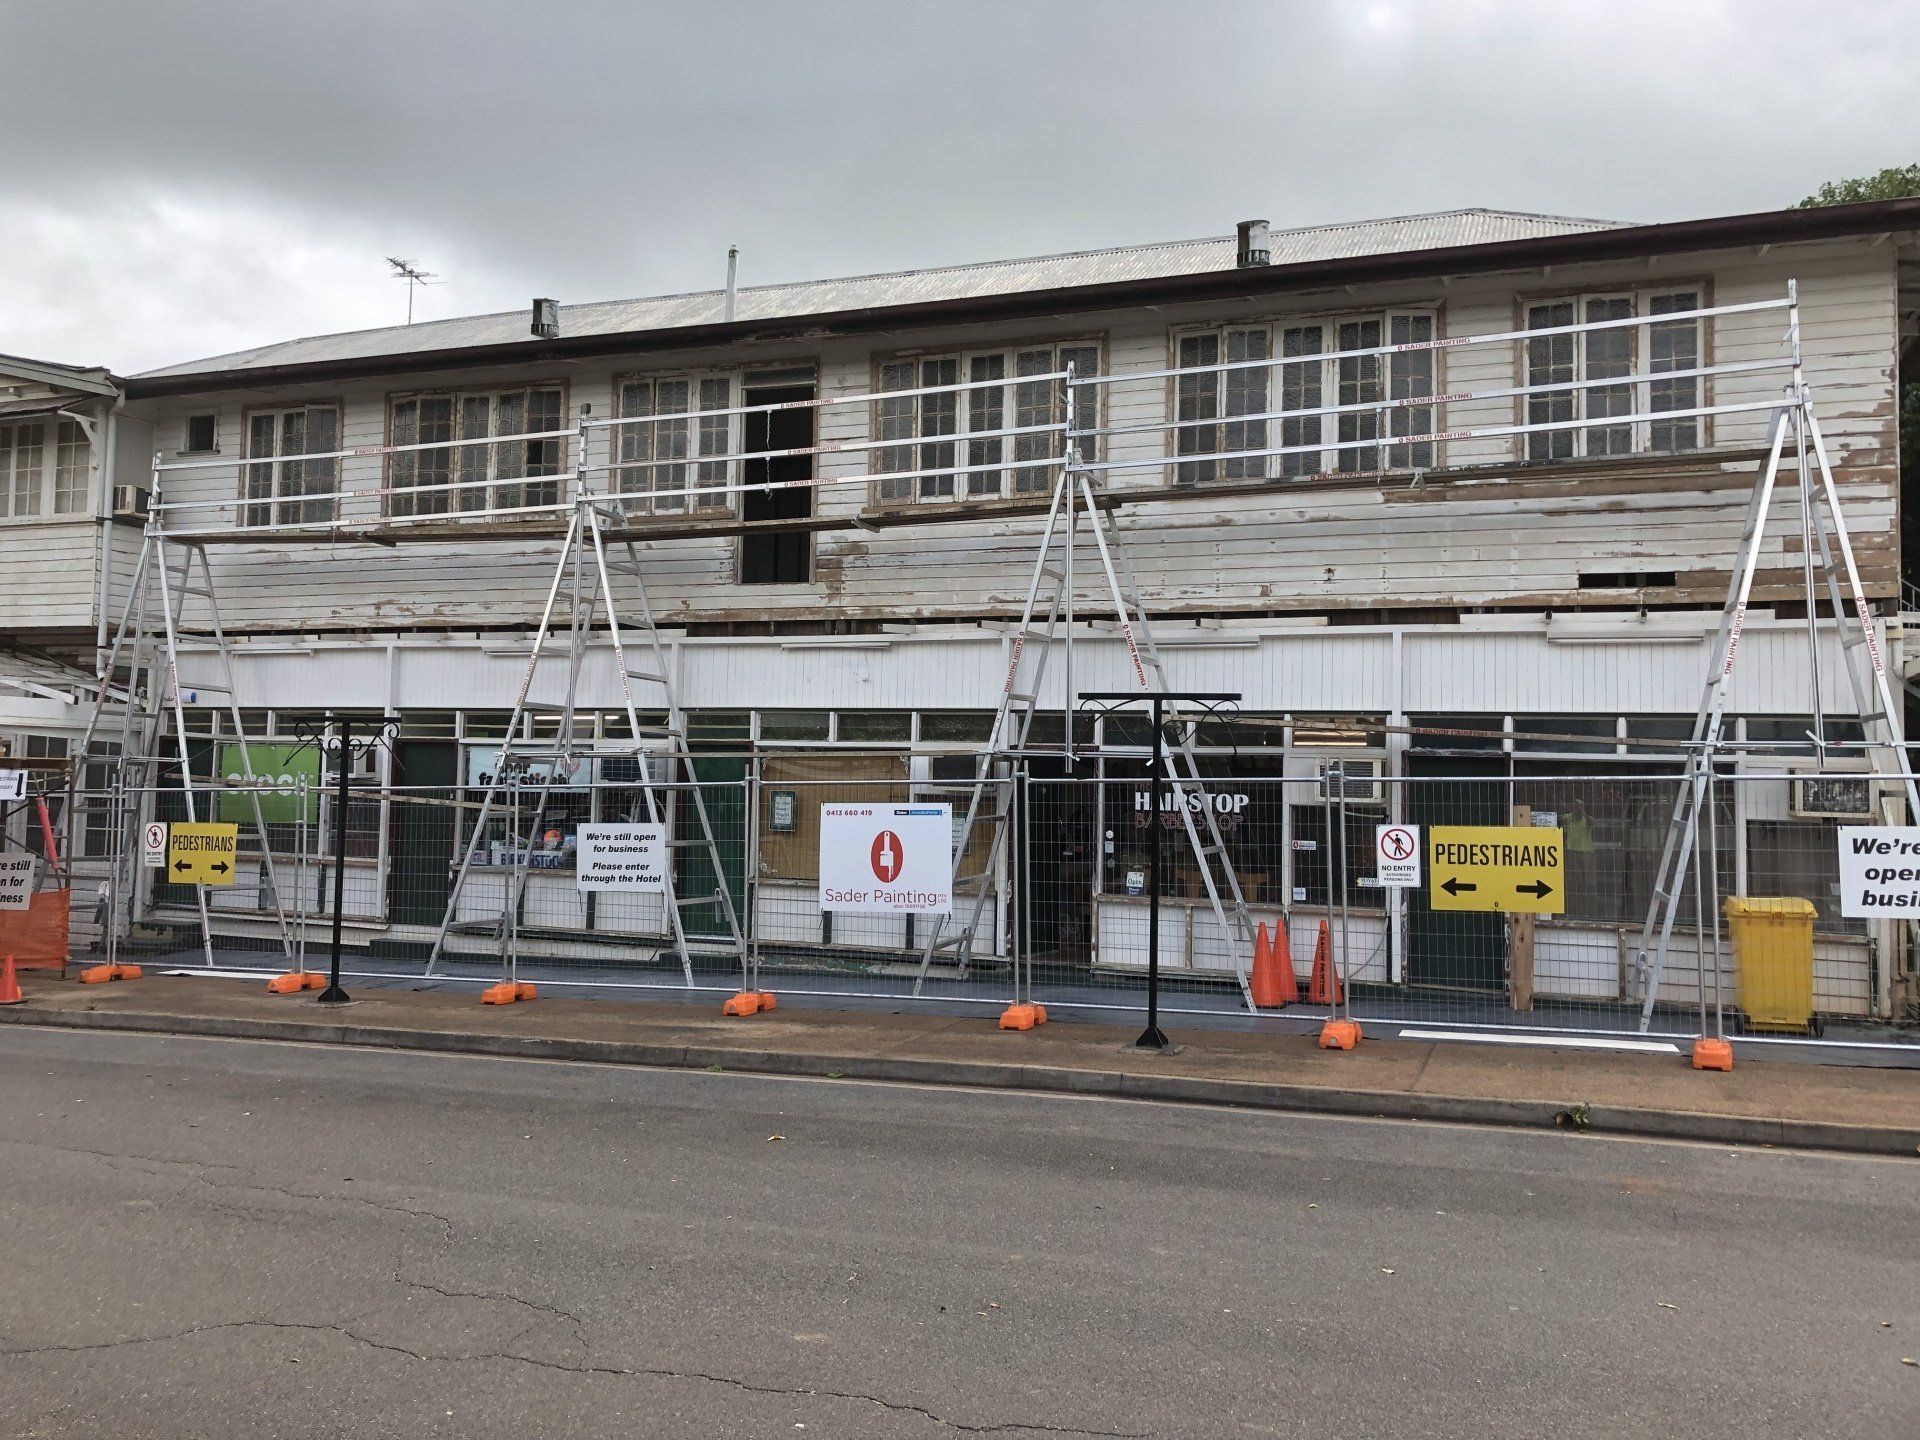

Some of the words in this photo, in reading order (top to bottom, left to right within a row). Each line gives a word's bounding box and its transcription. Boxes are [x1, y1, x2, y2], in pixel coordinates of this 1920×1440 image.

[1404, 342, 1432, 350] SADER
[1433, 337, 1471, 346] PAINTING
[1406, 397, 1433, 405] SADER
[1435, 392, 1473, 402] PAINTING
[1405, 434, 1432, 443] SADER
[1434, 430, 1472, 440] PAINTING
[1732, 608, 1745, 636] SADER
[1858, 603, 1872, 632] SADER
[1866, 632, 1883, 672] PAINTING
[1124, 629, 1136, 653] SADER
[1132, 653, 1147, 686] PAINTING
[1724, 637, 1738, 675] PAINTING
[172, 835, 234, 852] PEDESTRIANS
[586, 833, 611, 841] We're
[613, 833, 631, 841] still
[633, 834, 657, 842] open
[593, 845, 606, 853] for
[608, 845, 649, 853] business
[1435, 843, 1558, 867] PEDESTRIANS
[10, 860, 31, 871] still
[592, 862, 623, 871] Please
[625, 863, 650, 871] enter
[9, 876, 25, 887] for
[581, 874, 616, 884] through
[618, 874, 634, 882] the
[635, 874, 662, 882] Hotel
[825, 889, 868, 902] Sader
[873, 889, 937, 906] Painting
[1861, 890, 1920, 907] busi
